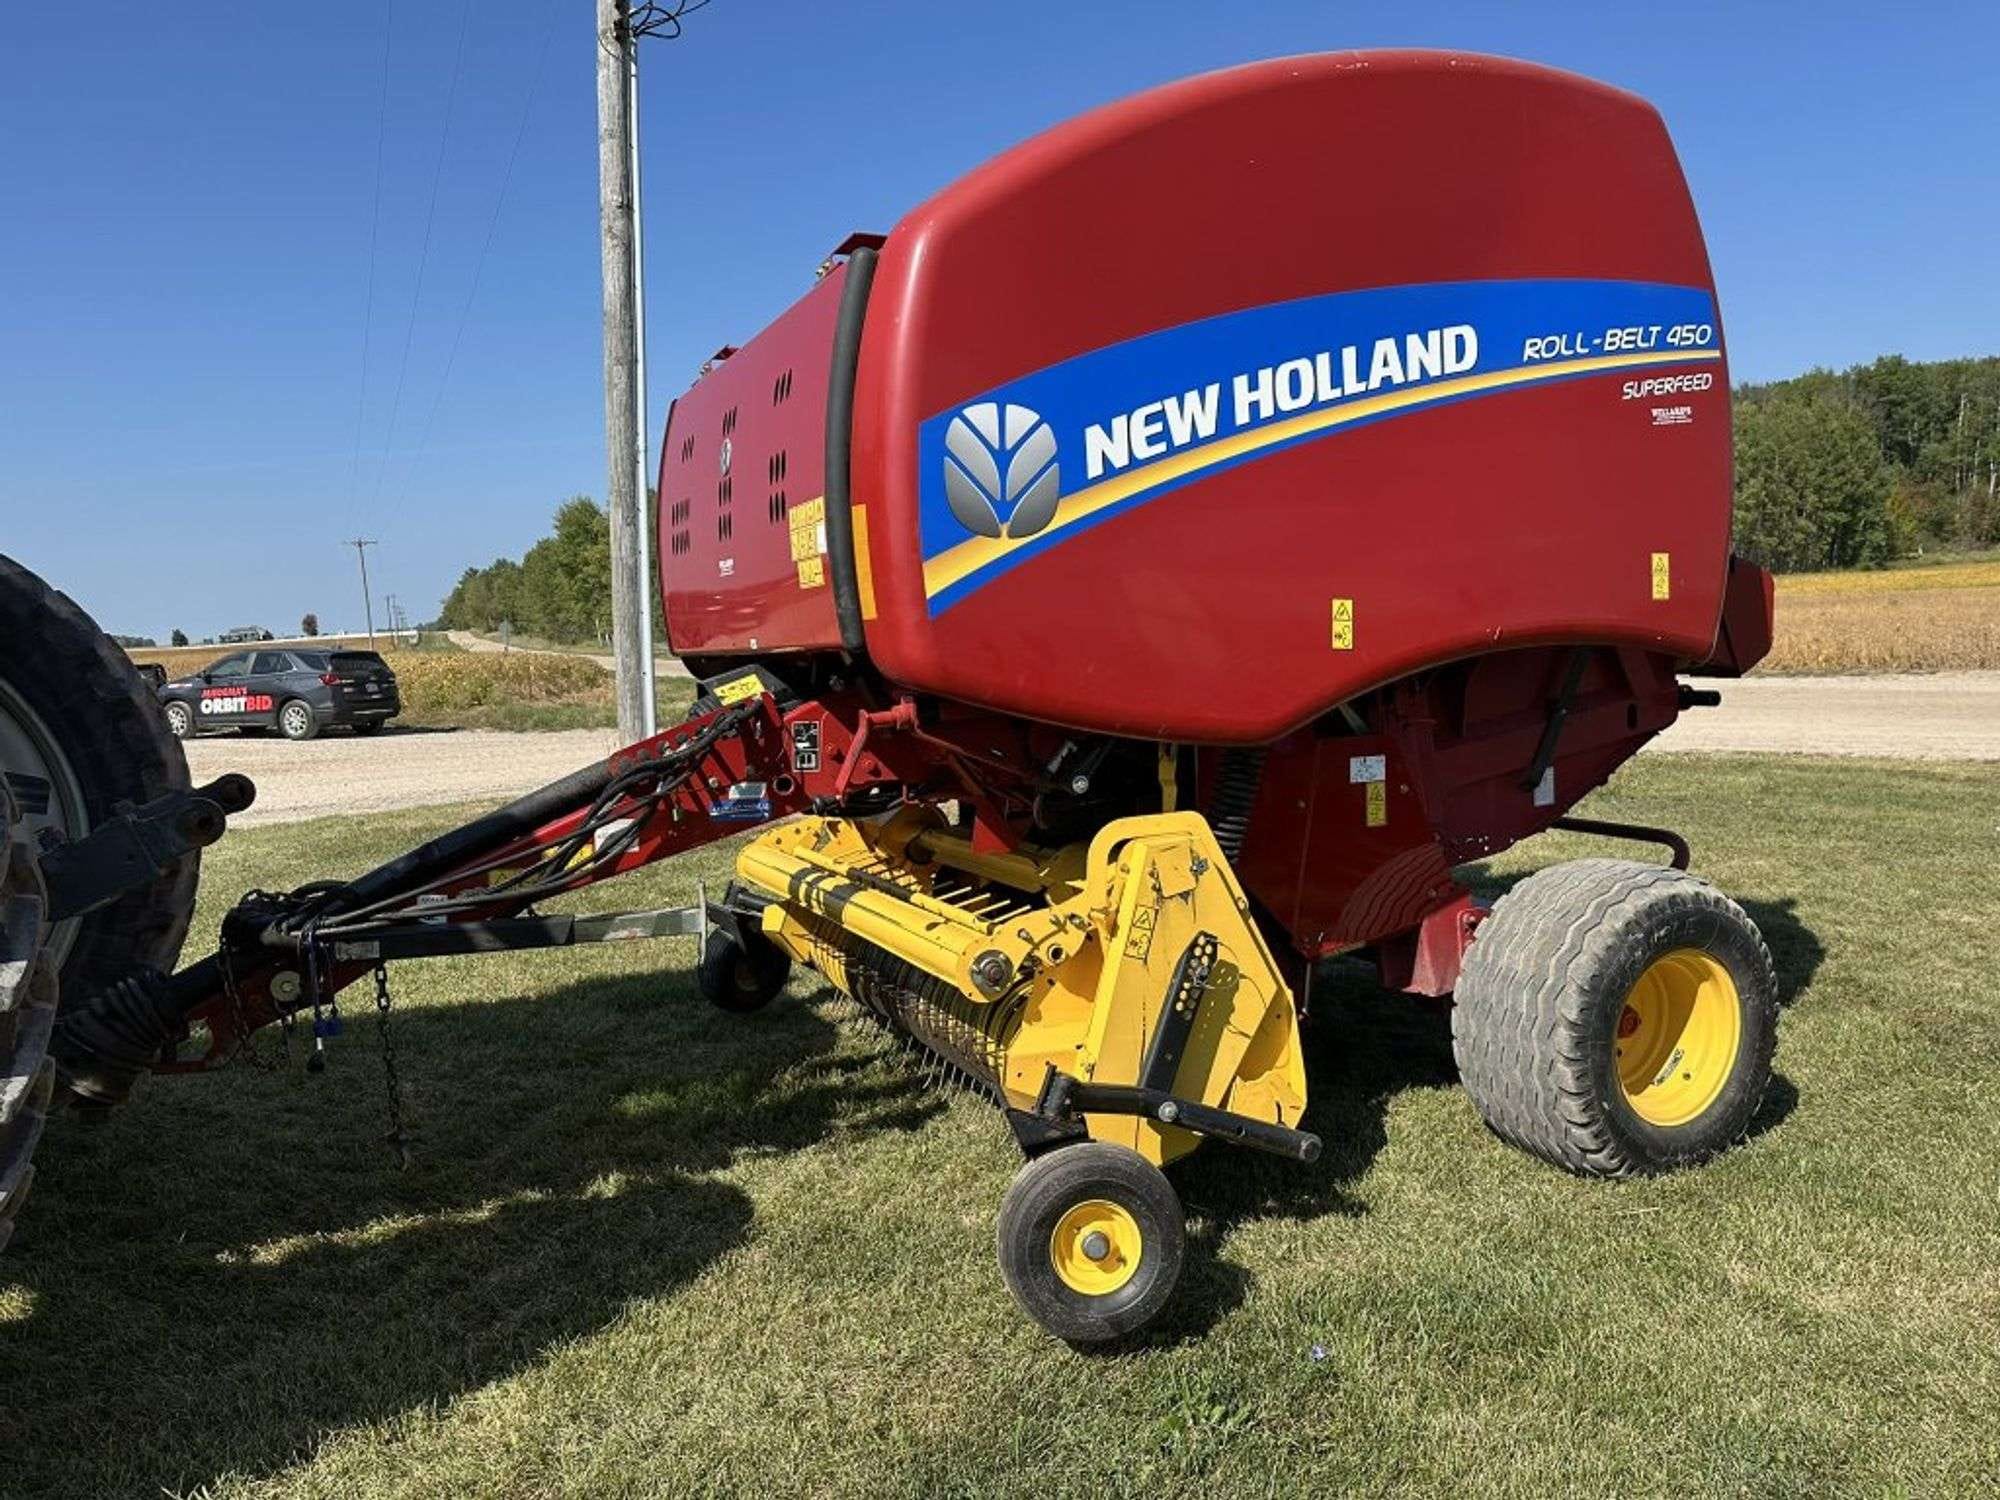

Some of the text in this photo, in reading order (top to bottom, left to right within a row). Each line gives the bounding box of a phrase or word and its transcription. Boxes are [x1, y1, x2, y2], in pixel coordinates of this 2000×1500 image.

[1666, 323, 1712, 347] 450
[1621, 372, 1713, 400] SUPERFEED
[1084, 323, 1479, 480] NEW HOLLAND
[201, 695, 273, 715] ORBITBID
